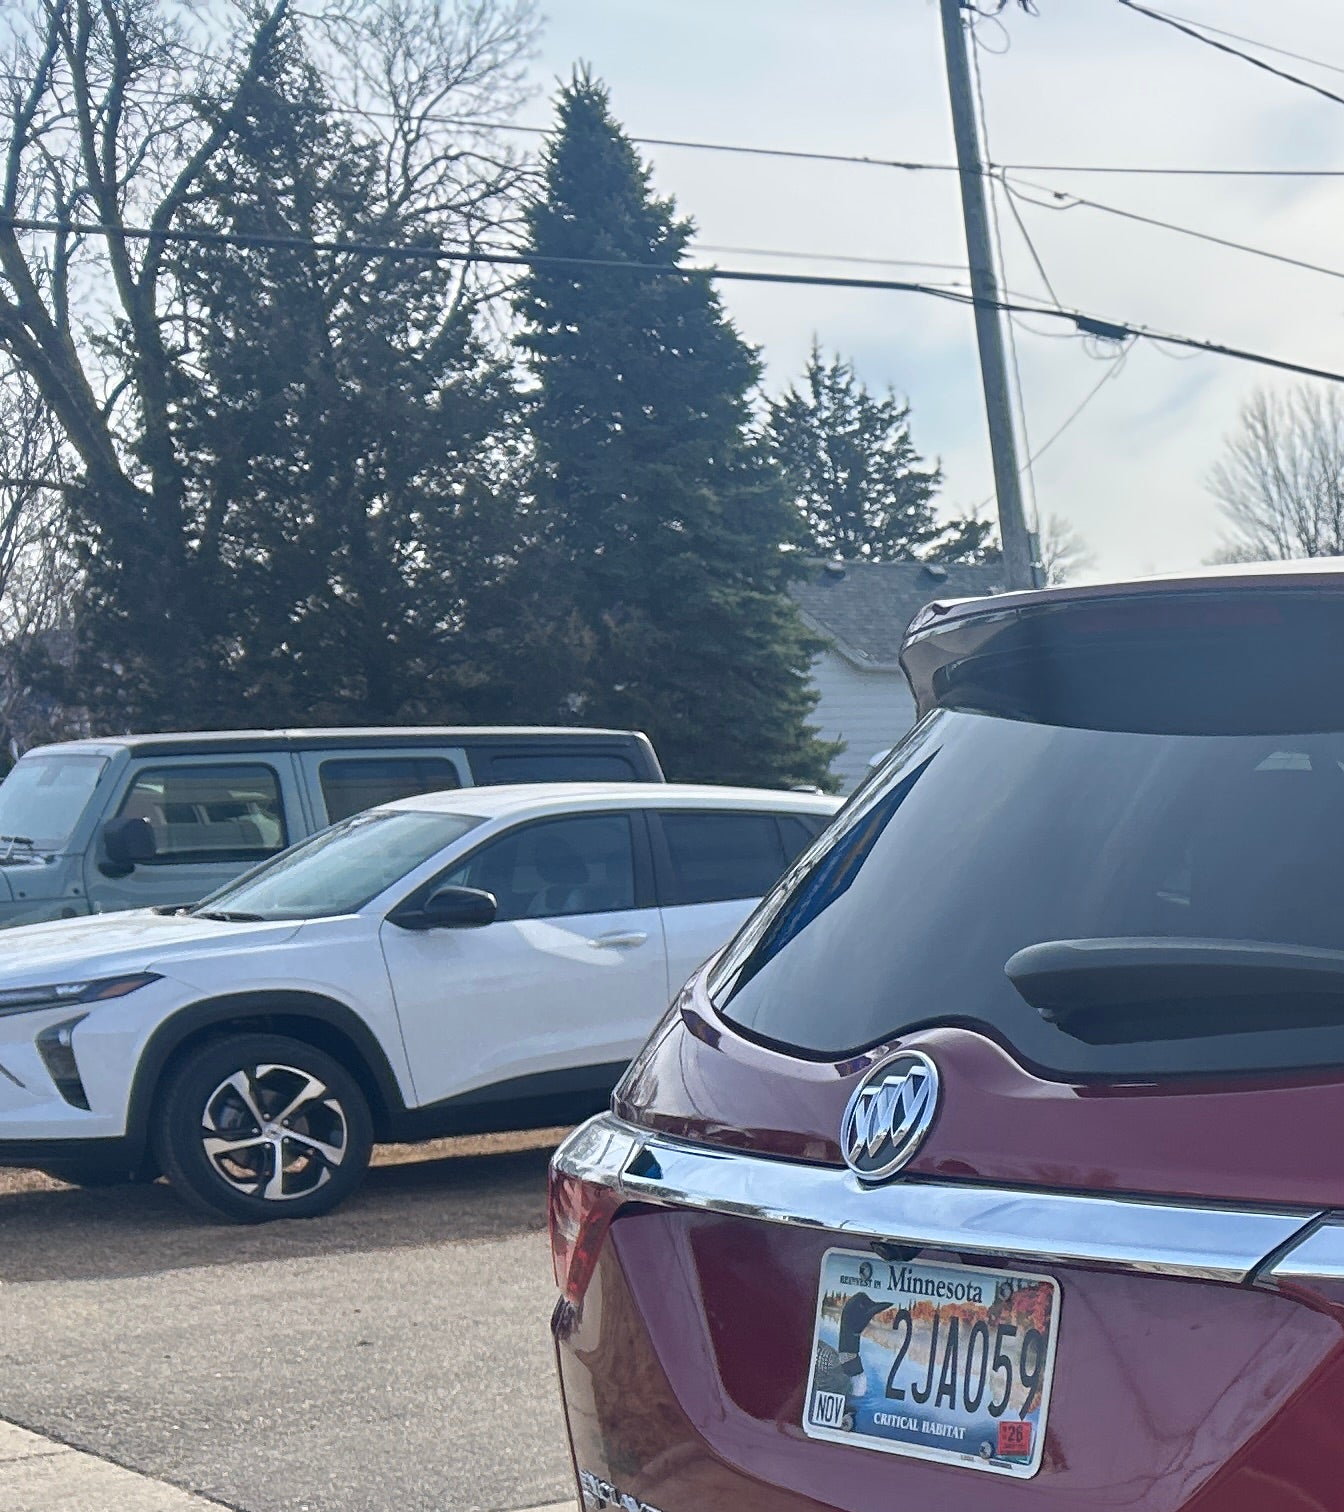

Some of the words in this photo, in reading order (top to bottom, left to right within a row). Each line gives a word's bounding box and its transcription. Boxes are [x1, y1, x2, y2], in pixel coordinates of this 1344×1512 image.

[887, 1265, 982, 1303] Minnesota
[885, 1309, 1042, 1420] 2JA059
[816, 1394, 843, 1424] NOV
[873, 1412, 918, 1432] CRITICAL
[921, 1421, 966, 1440] HABITAT
